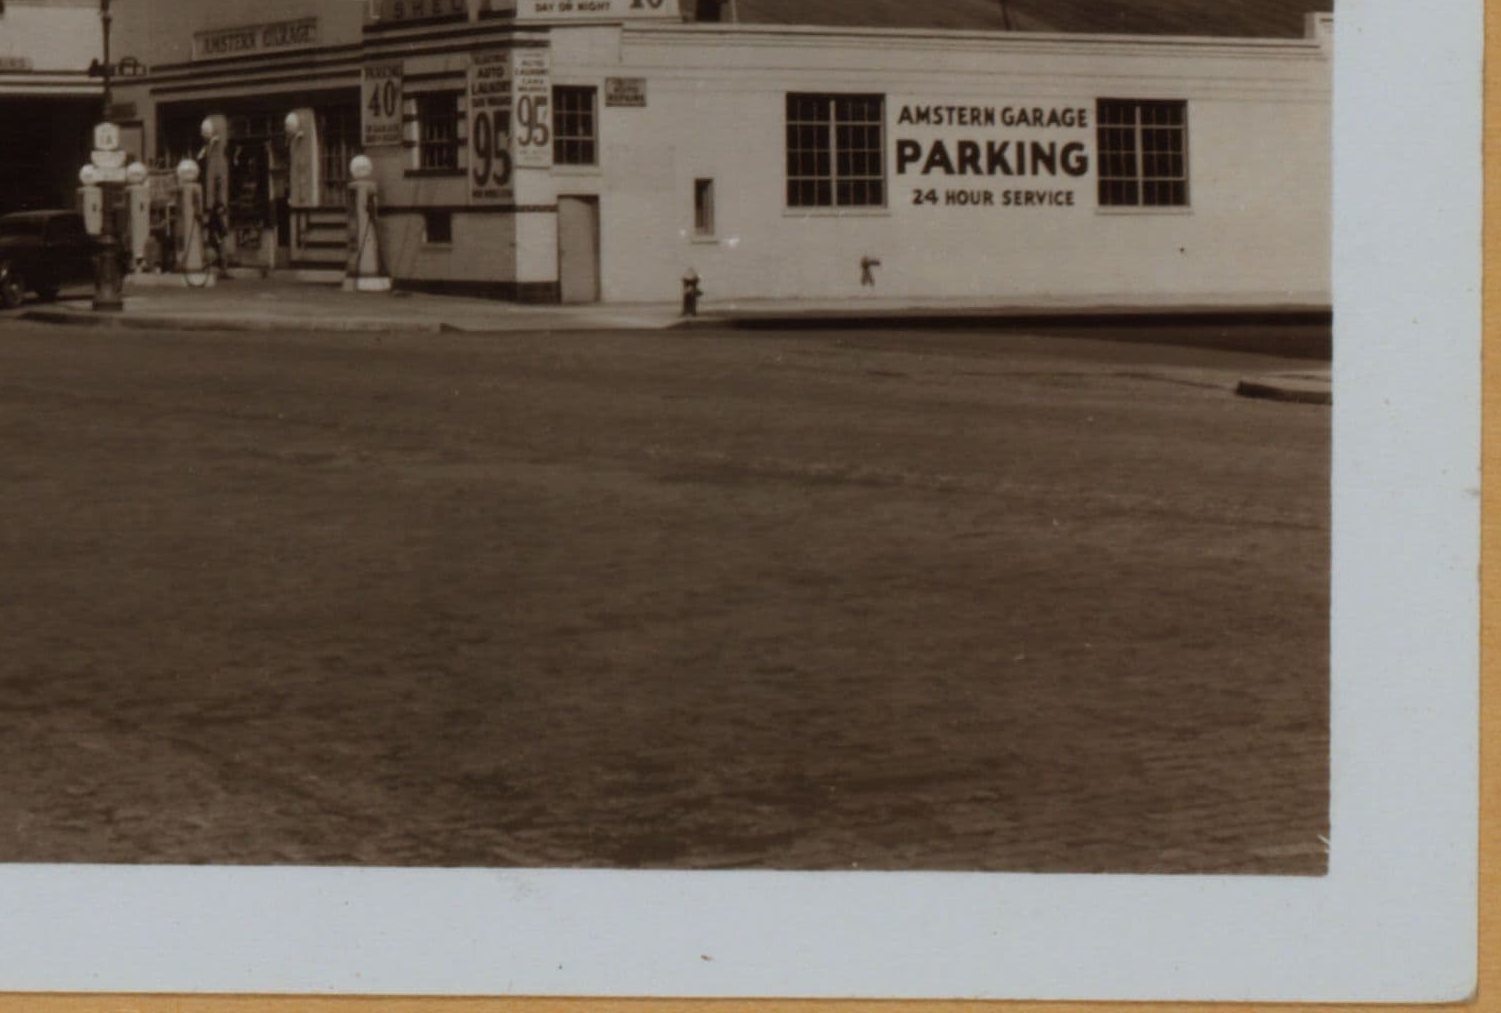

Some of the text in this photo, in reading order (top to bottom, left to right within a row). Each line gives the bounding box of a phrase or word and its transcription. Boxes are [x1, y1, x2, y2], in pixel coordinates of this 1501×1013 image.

[536, 2, 555, 12] DAY
[577, 2, 610, 12] NIGHT
[368, 80, 397, 118] 40
[897, 105, 1088, 128] AMSTERN GARAGE
[517, 94, 549, 147] 95
[473, 110, 512, 187] 95
[896, 139, 1089, 177] PARKING
[912, 189, 1075, 206] 24 HOUR SERVICE
